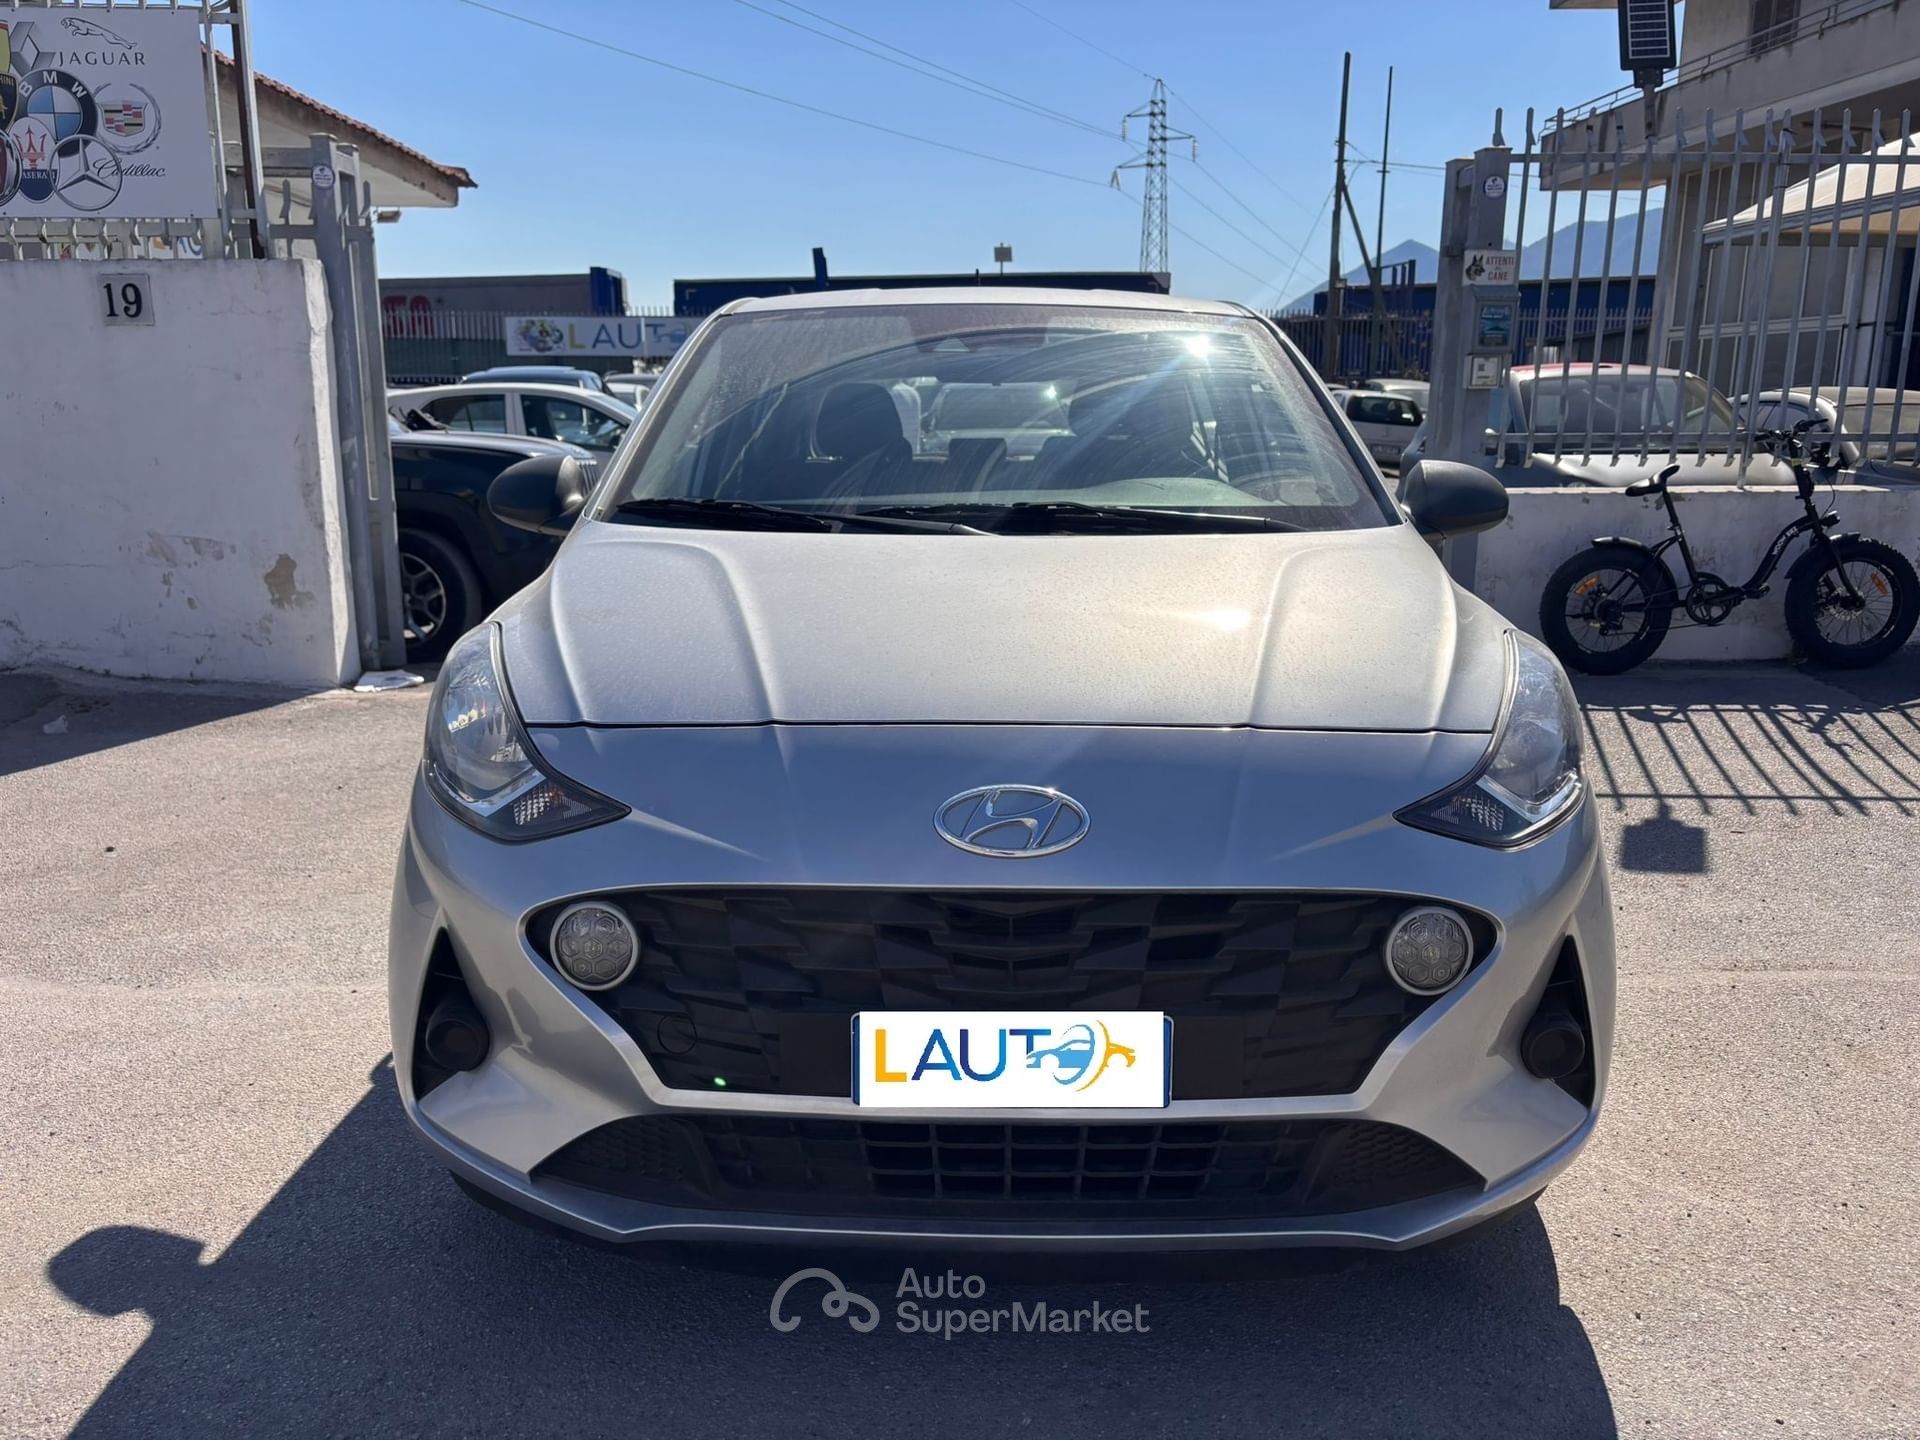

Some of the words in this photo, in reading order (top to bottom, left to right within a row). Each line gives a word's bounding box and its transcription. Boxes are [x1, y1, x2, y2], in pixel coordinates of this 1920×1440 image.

[58, 51, 145, 66] JAGUAR
[92, 157, 167, 178] Cadillac
[1488, 271, 1508, 280] CANE
[103, 283, 142, 318] 19
